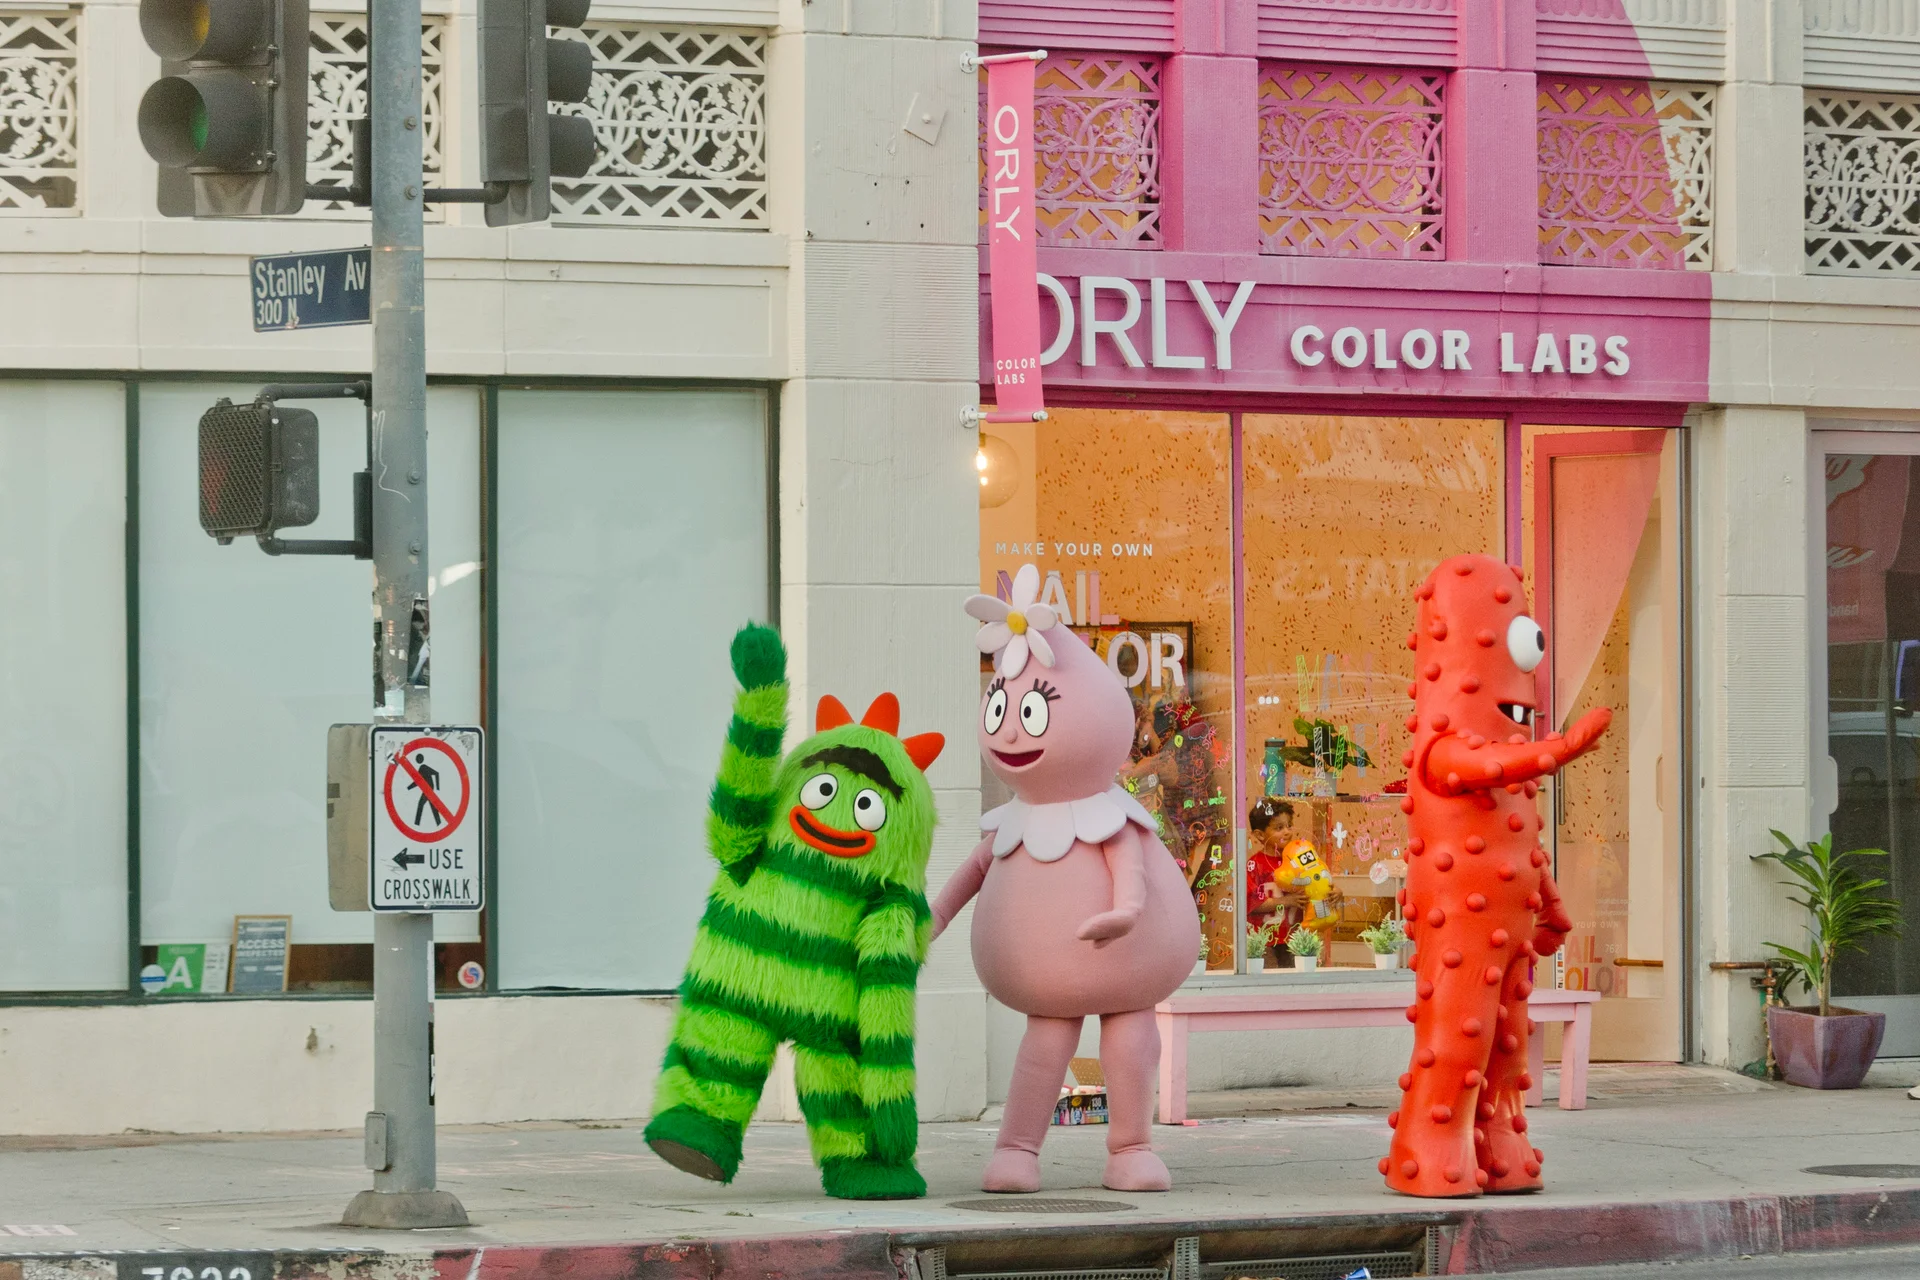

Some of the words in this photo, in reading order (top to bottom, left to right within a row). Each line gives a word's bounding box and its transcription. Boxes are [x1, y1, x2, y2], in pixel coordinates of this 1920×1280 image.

[255, 258, 326, 304] Stanley
[344, 254, 367, 291] Av
[256, 299, 282, 325] 300
[1290, 325, 1472, 370] COLOR
[1501, 333, 1630, 376] LABS
[996, 357, 1036, 371] COLOR
[997, 373, 1026, 385] LABS
[995, 542, 1045, 556] MAKE
[1055, 542, 1102, 556] YOUR
[1112, 543, 1153, 557] OWN
[429, 849, 464, 870] USE
[384, 878, 471, 900] CROSSWALK
[237, 939, 285, 949] ACCESS
[1566, 935, 1602, 963] AIL
[165, 956, 194, 989] A
